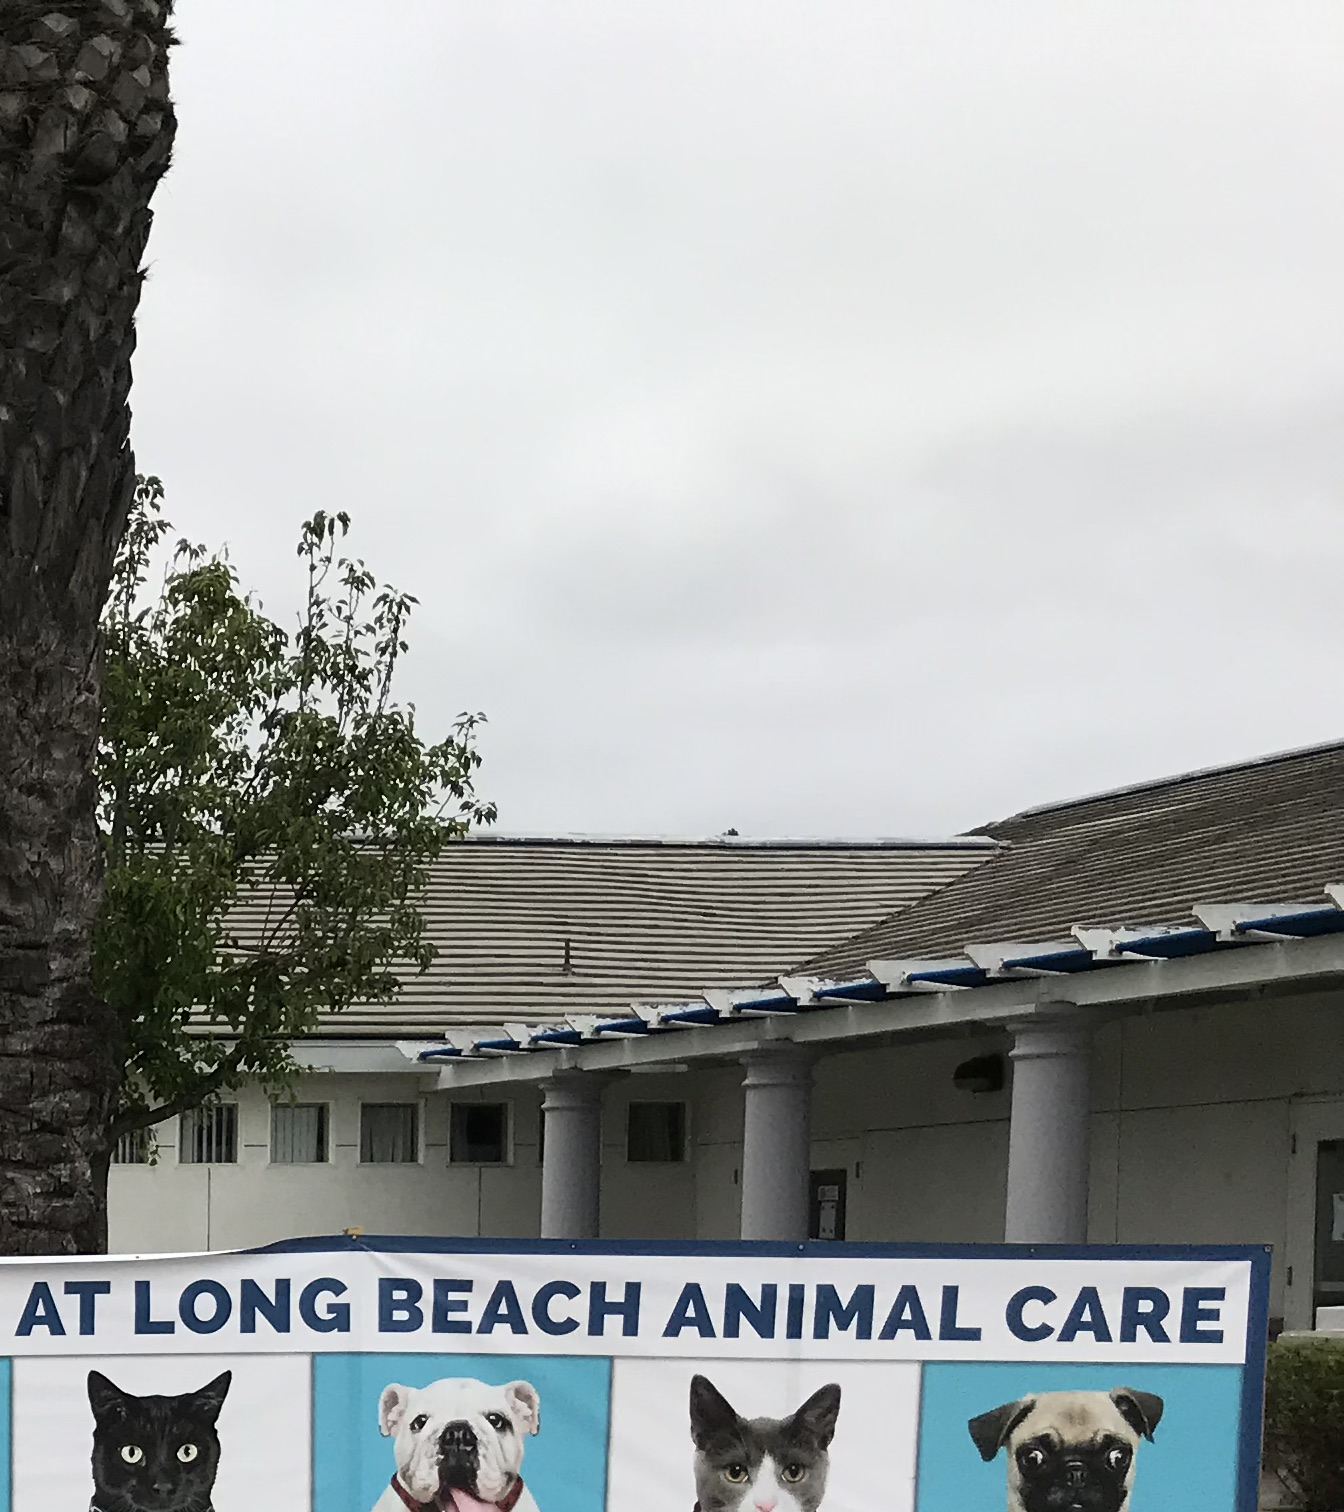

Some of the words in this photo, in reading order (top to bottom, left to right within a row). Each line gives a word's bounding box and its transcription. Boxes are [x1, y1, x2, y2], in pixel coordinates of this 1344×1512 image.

[14, 1280, 112, 1337] AT
[134, 1277, 351, 1335] LONG
[378, 1277, 642, 1338] BEACH
[661, 1282, 982, 1342] ANIMAL
[1005, 1285, 1227, 1344] CARE
